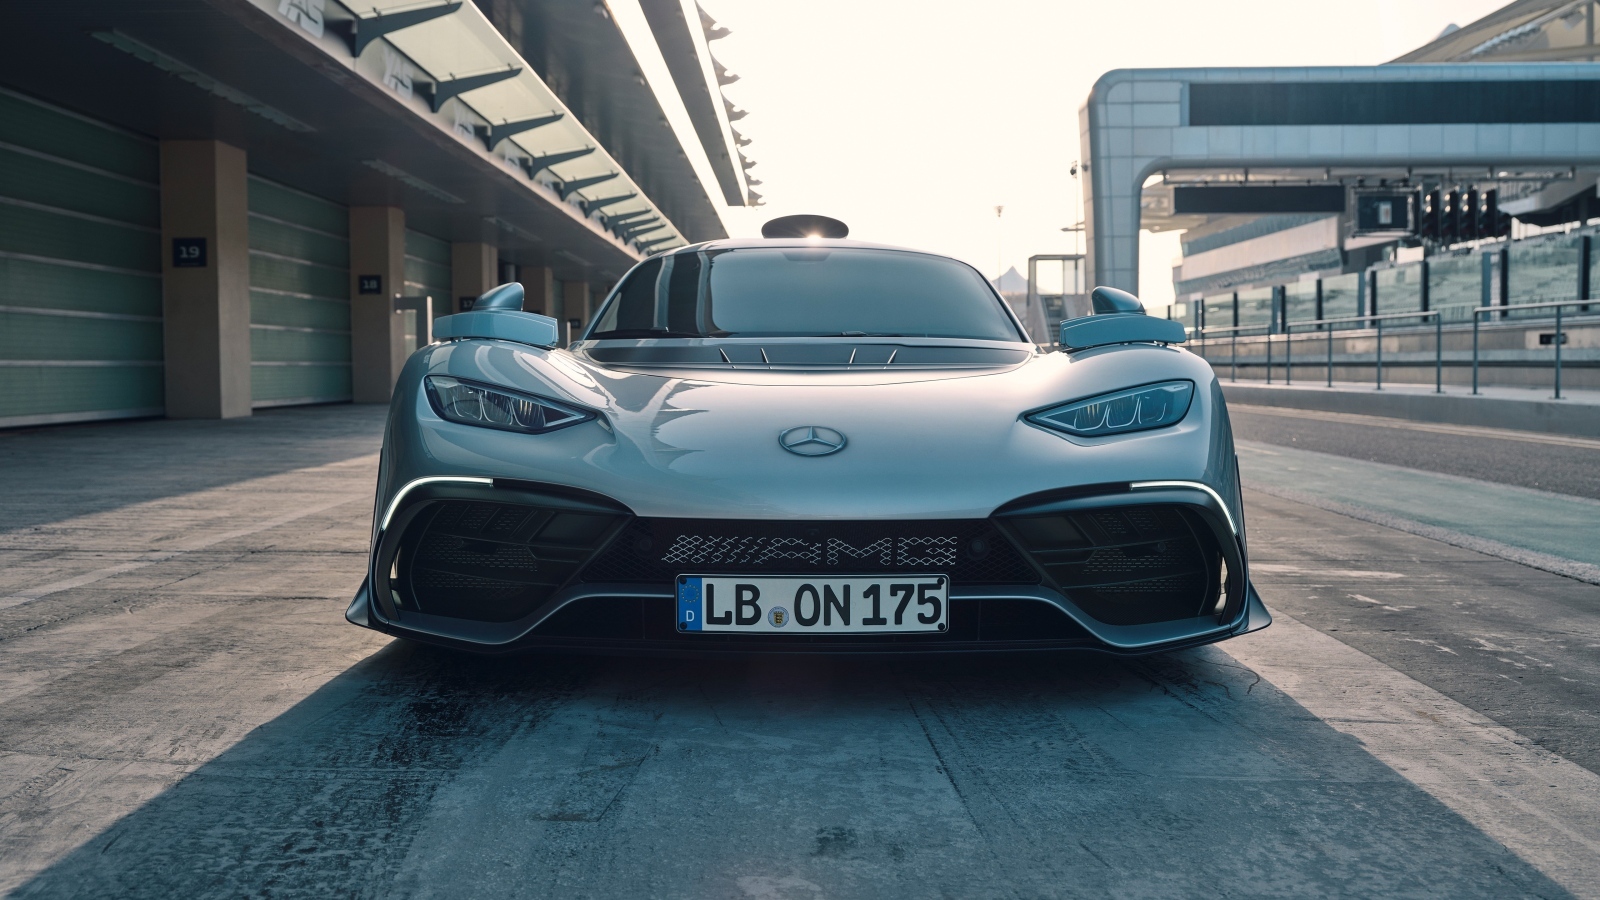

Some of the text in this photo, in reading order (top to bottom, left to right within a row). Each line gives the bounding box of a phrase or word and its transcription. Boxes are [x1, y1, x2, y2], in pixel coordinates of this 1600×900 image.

[179, 246, 200, 258] 19
[363, 279, 378, 289] 18
[706, 583, 942, 626] LB ON 175
[685, 610, 695, 622] D
